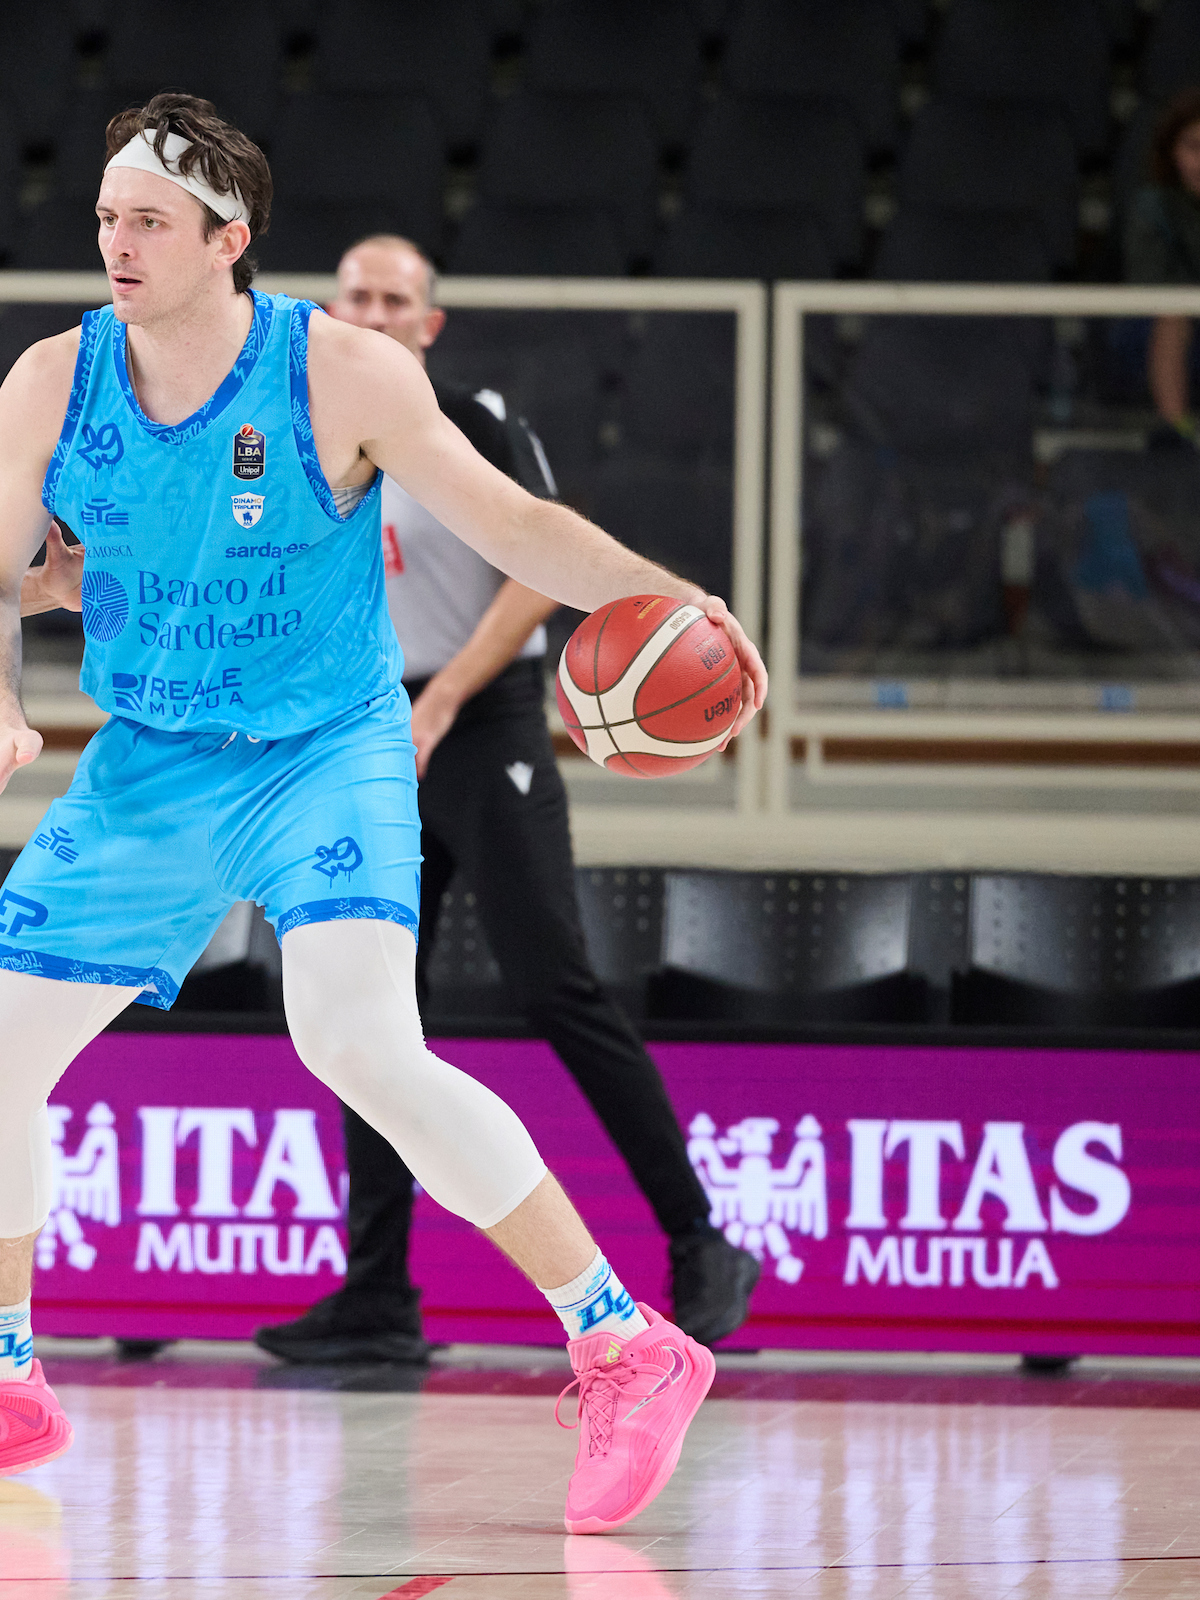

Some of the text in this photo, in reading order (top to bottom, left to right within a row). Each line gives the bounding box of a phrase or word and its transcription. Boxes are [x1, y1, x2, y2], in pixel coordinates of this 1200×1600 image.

[237, 447, 261, 457] LBA
[239, 465, 260, 475] Unipol
[137, 565, 287, 608] Banco di
[139, 609, 302, 651] Sardegna
[701, 643, 726, 671] FIBA
[150, 668, 243, 700] REALE
[150, 691, 244, 718] MUTUA
[312, 836, 364, 889] 29
[136, 1107, 350, 1220] ITA
[845, 1119, 1132, 1236] ITAS
[135, 1222, 349, 1276] MUTUA
[844, 1235, 1059, 1288] MUTUA
